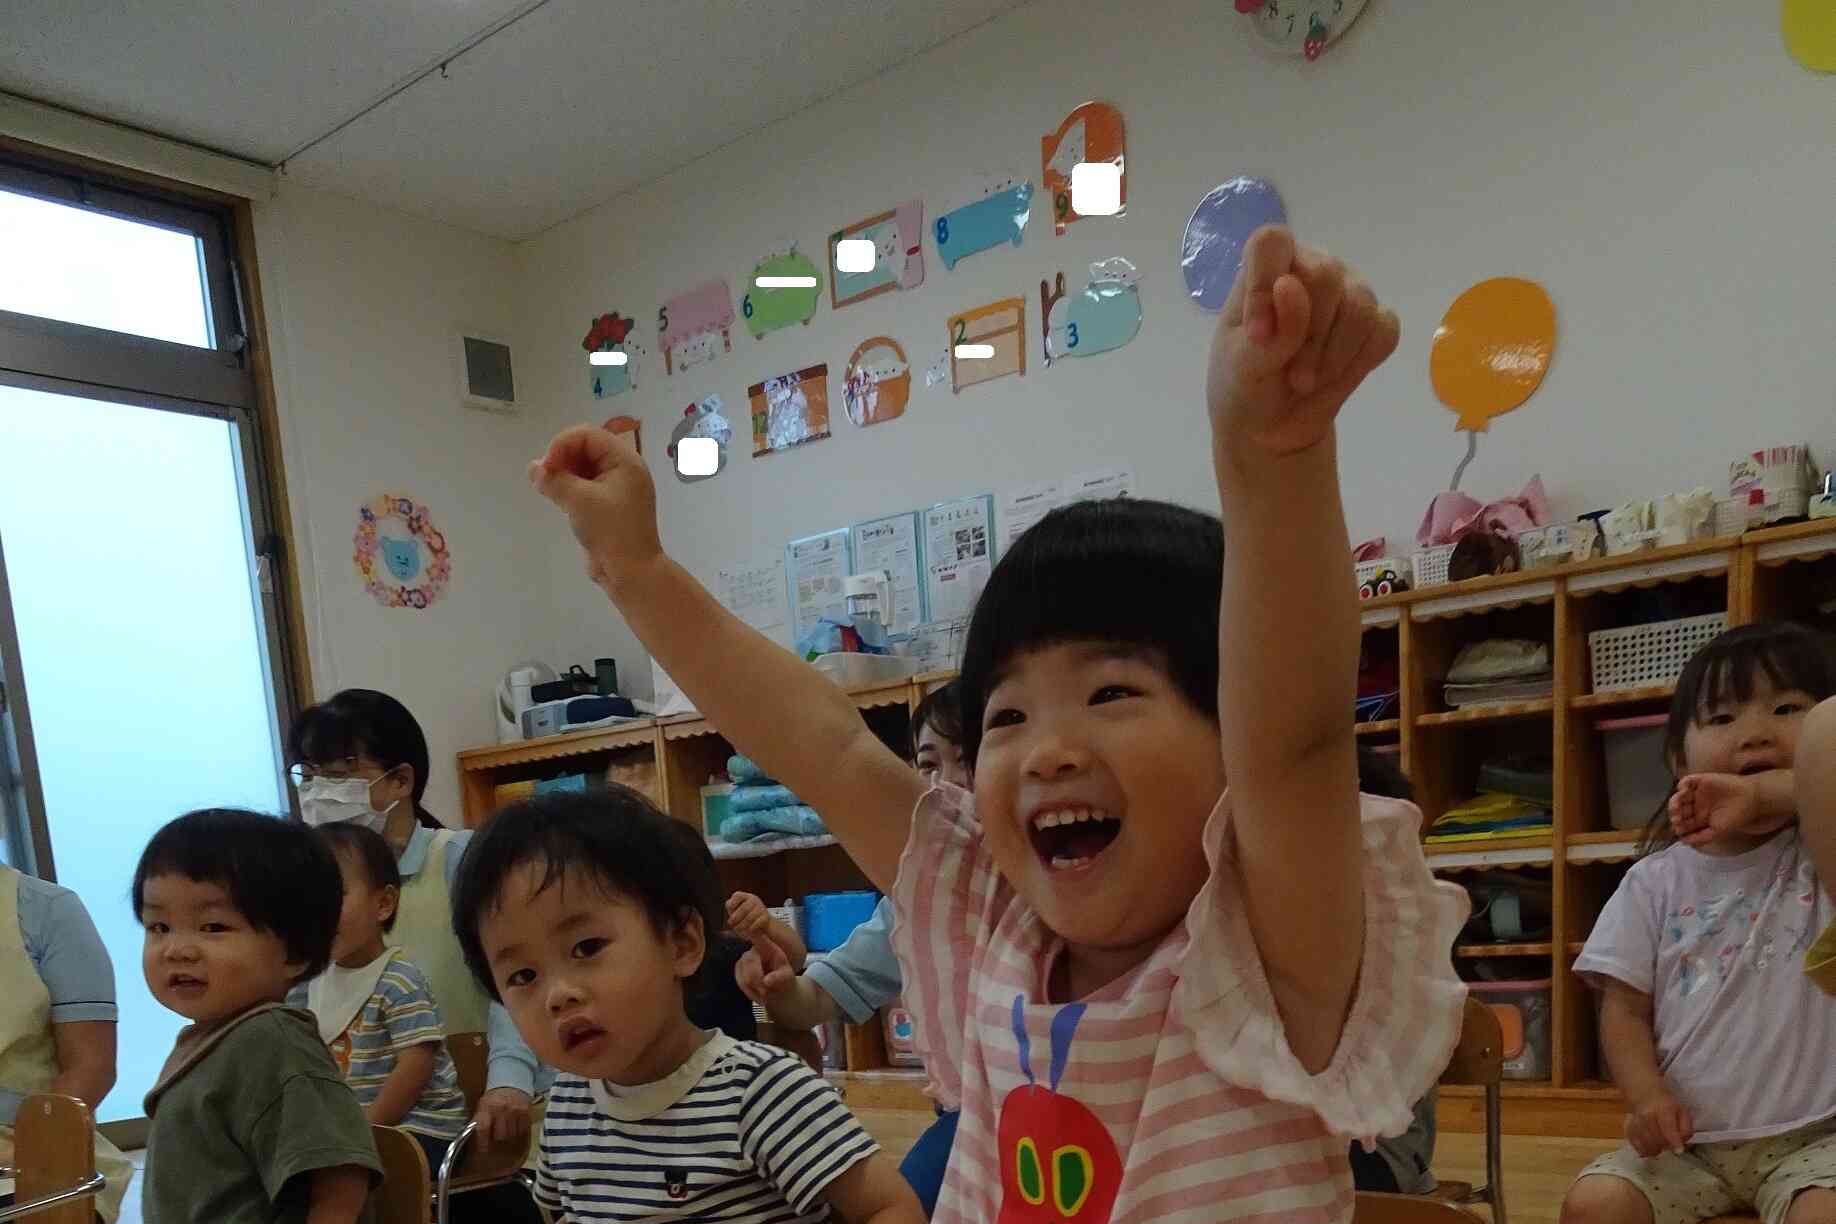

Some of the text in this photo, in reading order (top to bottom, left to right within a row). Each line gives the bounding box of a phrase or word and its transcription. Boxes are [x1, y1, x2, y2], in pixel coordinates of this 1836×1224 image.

[1285, 14, 1295, 34] 7
[1056, 193, 1069, 219] 9
[936, 216, 949, 244] 8
[658, 305, 669, 332] 5
[743, 294, 753, 319] 6
[953, 318, 968, 346] 2
[1066, 322, 1080, 349] 3
[593, 377, 603, 398] 4
